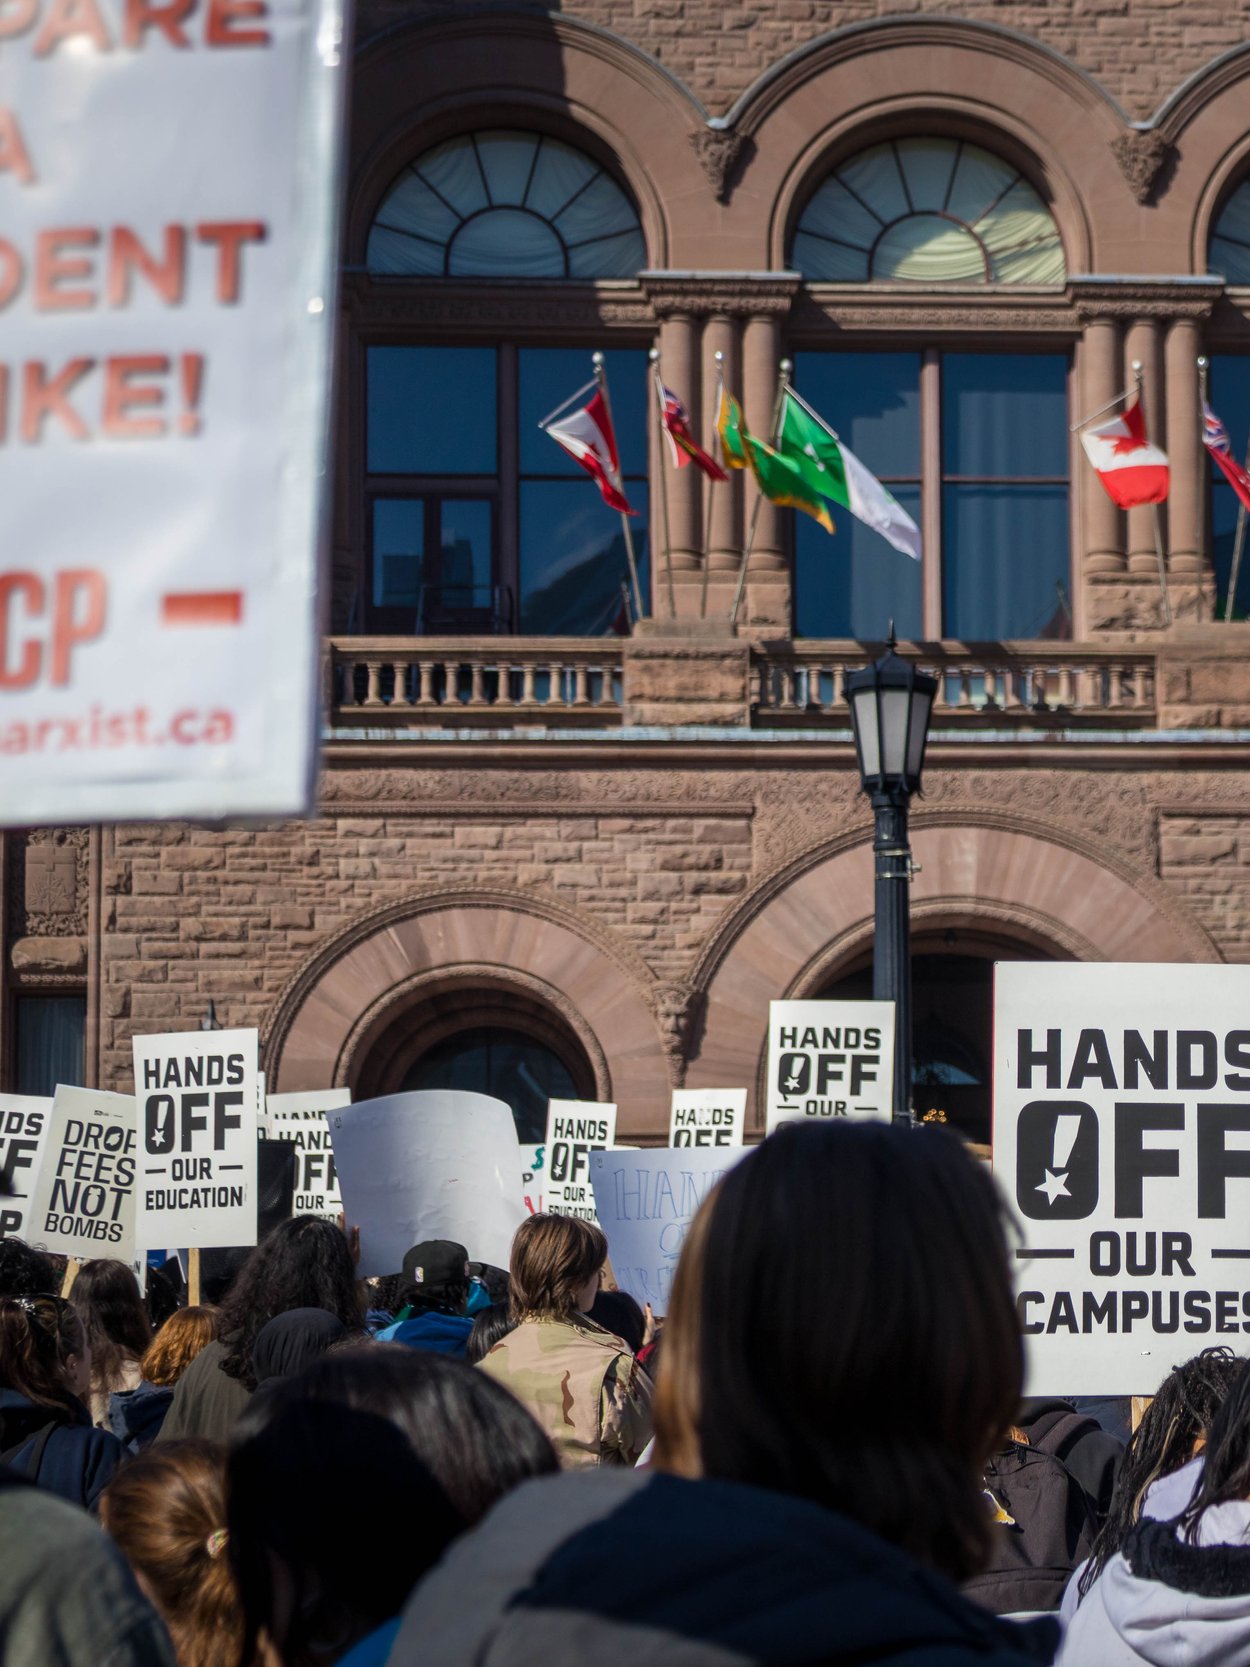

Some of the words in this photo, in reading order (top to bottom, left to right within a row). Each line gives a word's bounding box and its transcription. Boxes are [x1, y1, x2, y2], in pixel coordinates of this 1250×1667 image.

[780, 1027, 881, 1049] HANDS
[144, 1054, 244, 1089] HANDS
[778, 1053, 880, 1096] OFF
[675, 1109, 734, 1126] HADS
[805, 1100, 847, 1116] OUR
[0, 1111, 44, 1136] DS
[145, 1091, 243, 1154] OFF
[554, 1118, 608, 1141] HANDS
[56, 1148, 136, 1187] FEES
[172, 1158, 212, 1181] OUR
[49, 1178, 132, 1221] NOT
[145, 1186, 243, 1210] EDUCATION
[296, 1195, 324, 1209] OUR
[564, 1186, 586, 1202] OUR
[44, 1213, 123, 1242] BOMBS
[1089, 1231, 1197, 1276] OUR
